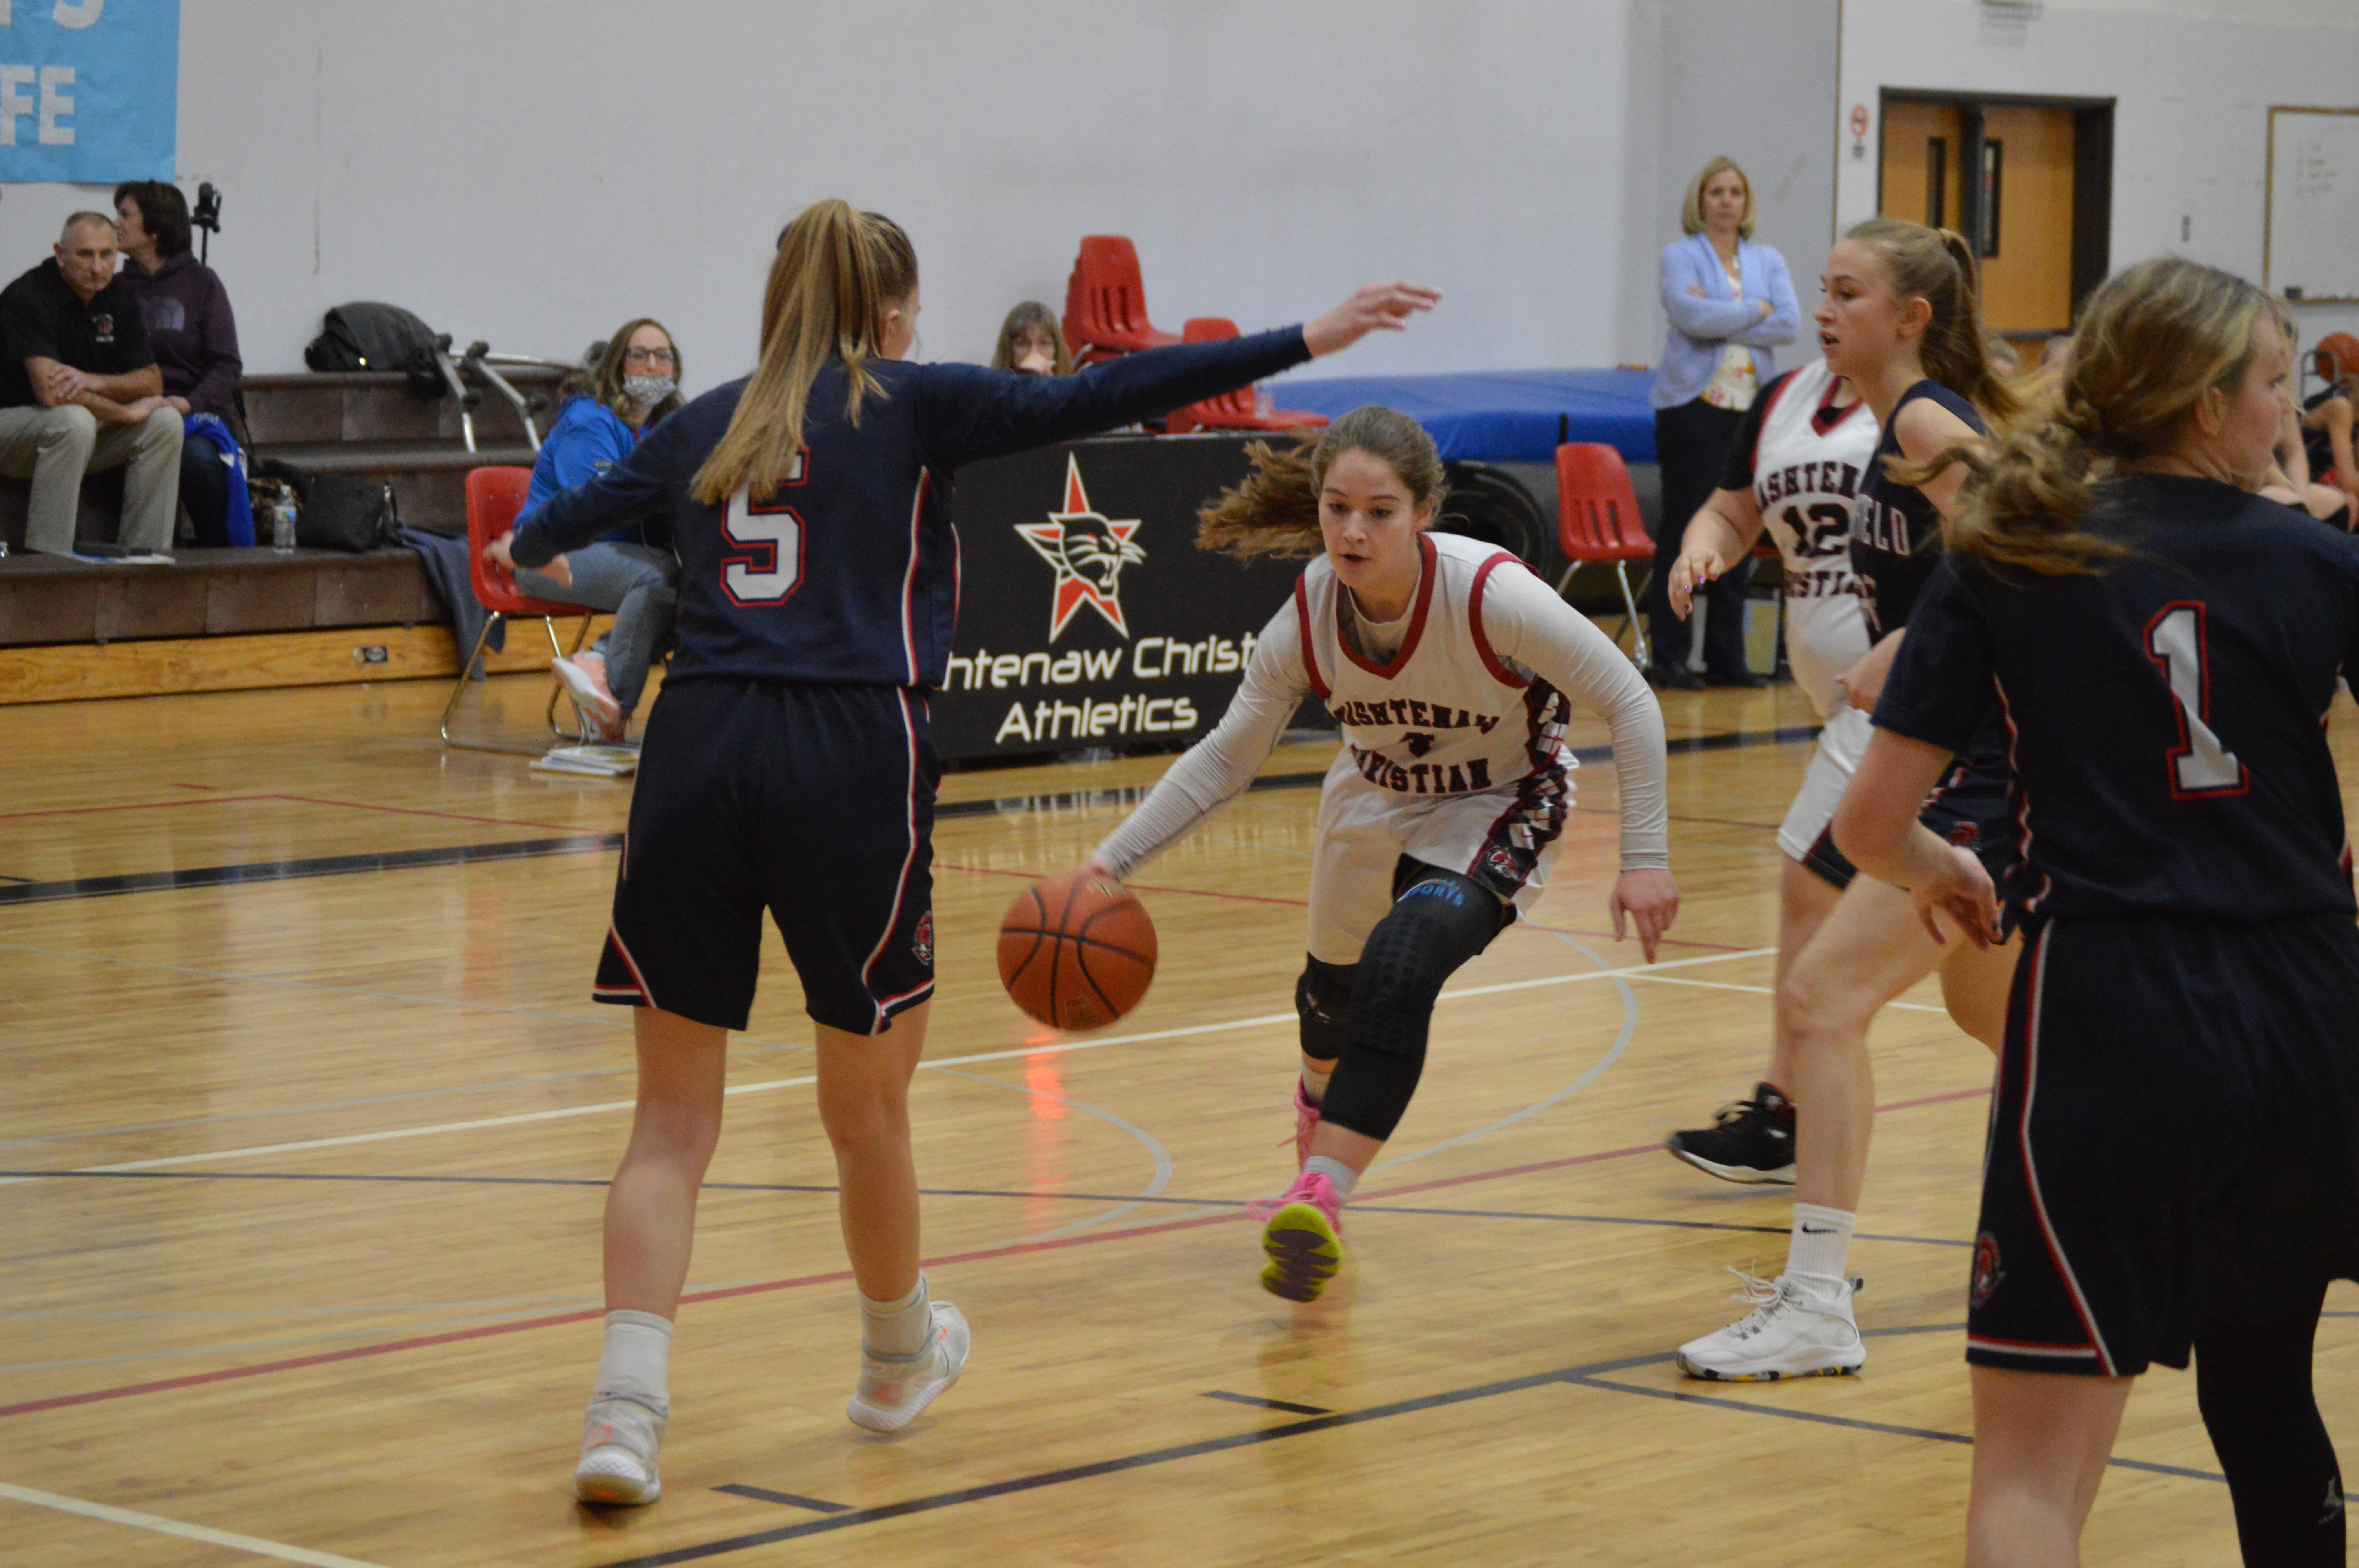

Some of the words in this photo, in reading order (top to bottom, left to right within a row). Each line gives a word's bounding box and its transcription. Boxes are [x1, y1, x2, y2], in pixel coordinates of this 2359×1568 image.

[720, 446, 811, 607] 5
[1783, 503, 1849, 558] 12
[994, 693, 1198, 744] Athletics
[2142, 600, 2250, 800] 1
[1350, 742, 1492, 793] RISTIAN
